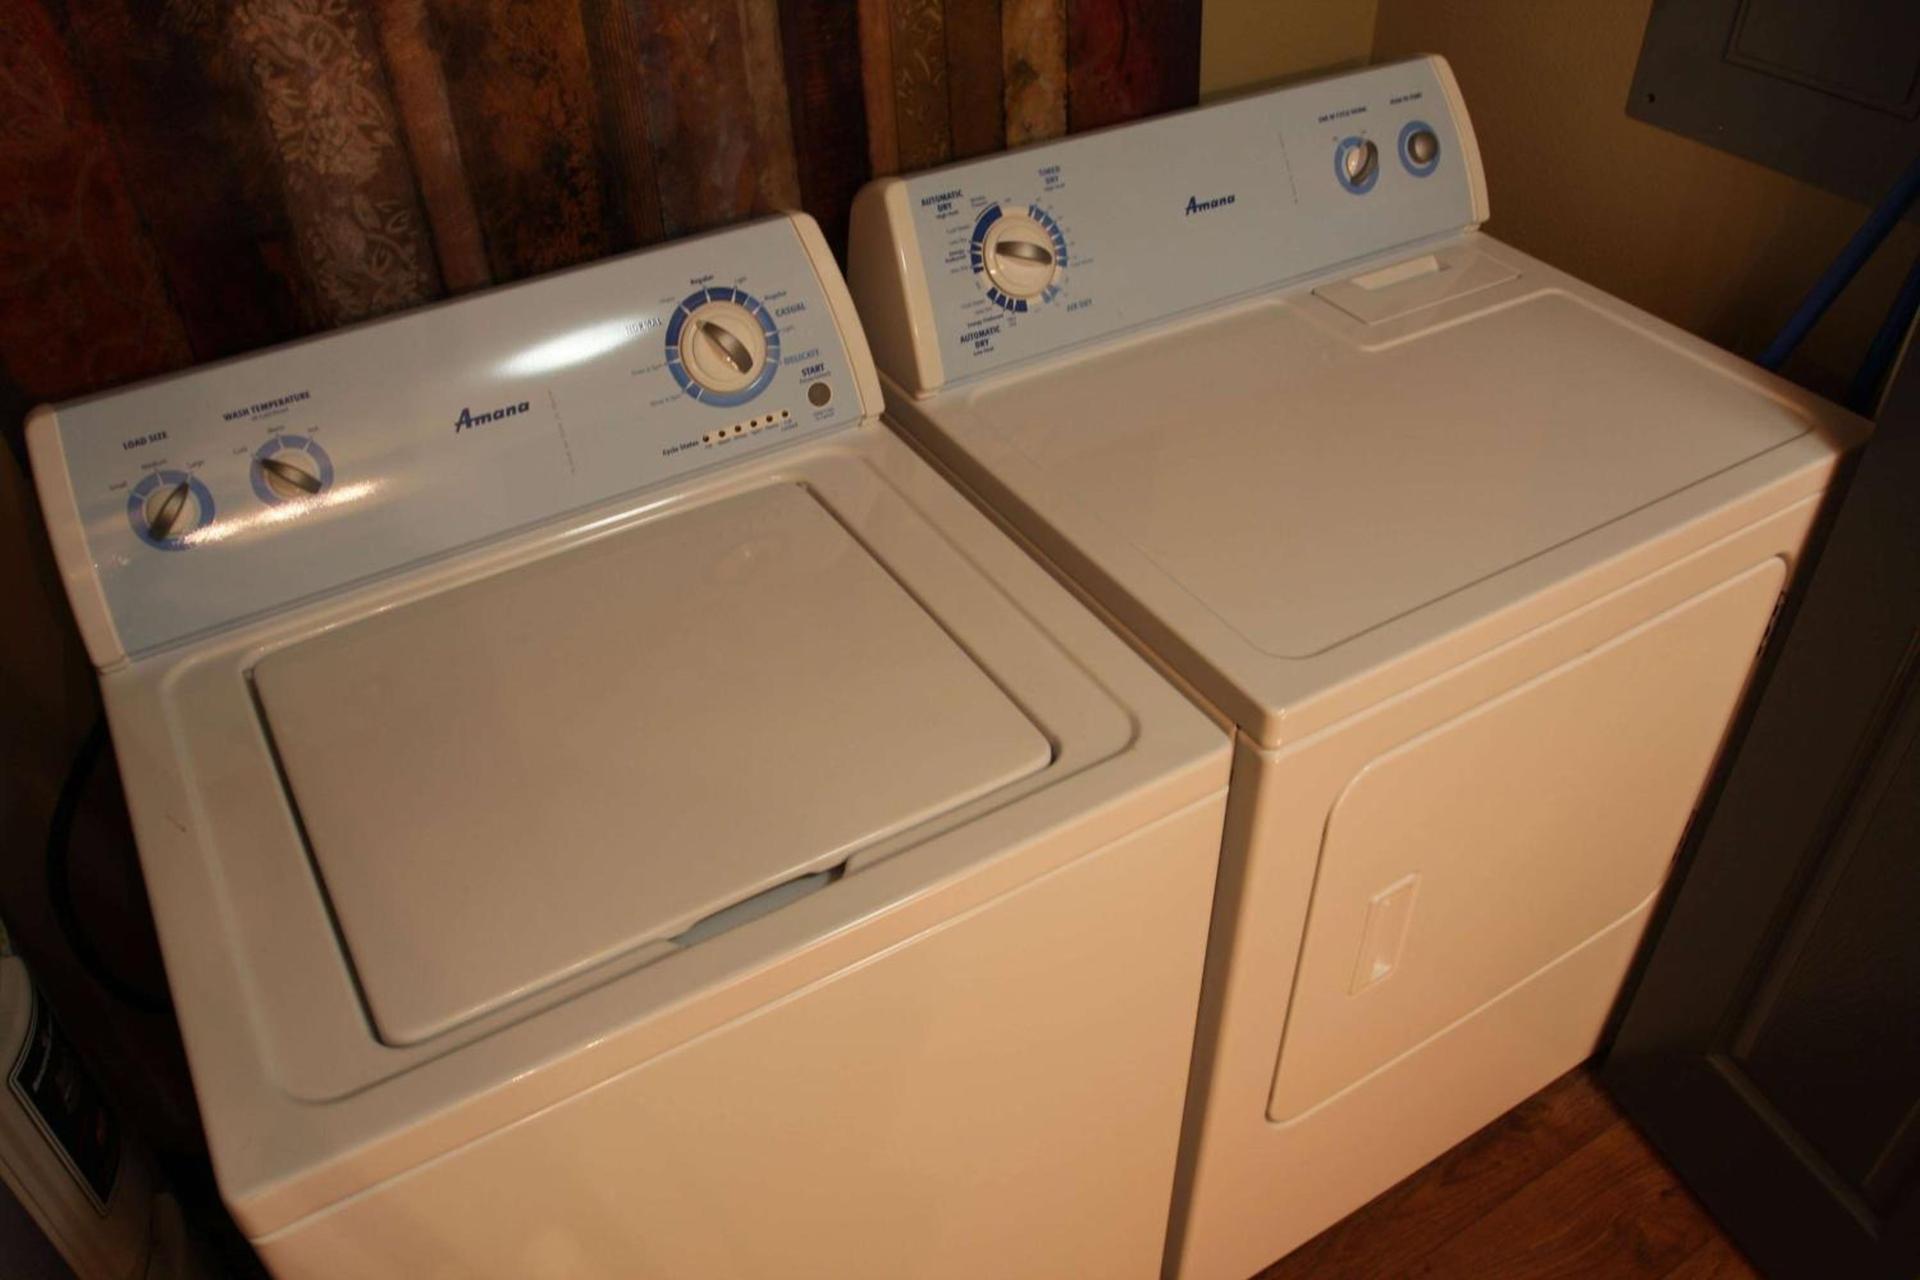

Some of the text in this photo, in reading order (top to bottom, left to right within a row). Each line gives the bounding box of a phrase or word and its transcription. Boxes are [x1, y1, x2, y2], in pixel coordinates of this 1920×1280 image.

[921, 189, 963, 206] AUTOMATIC
[1185, 195, 1235, 216] Amana
[937, 202, 952, 212] DRY
[775, 302, 806, 318] CASUAL
[960, 324, 1000, 344] AUTOMATIC
[974, 338, 989, 349] DRY
[801, 363, 825, 378] START
[222, 407, 249, 421] WASH
[250, 390, 311, 413] TEMPERATURE
[454, 401, 530, 434] Amana
[122, 430, 168, 450] LOAD SIZE
